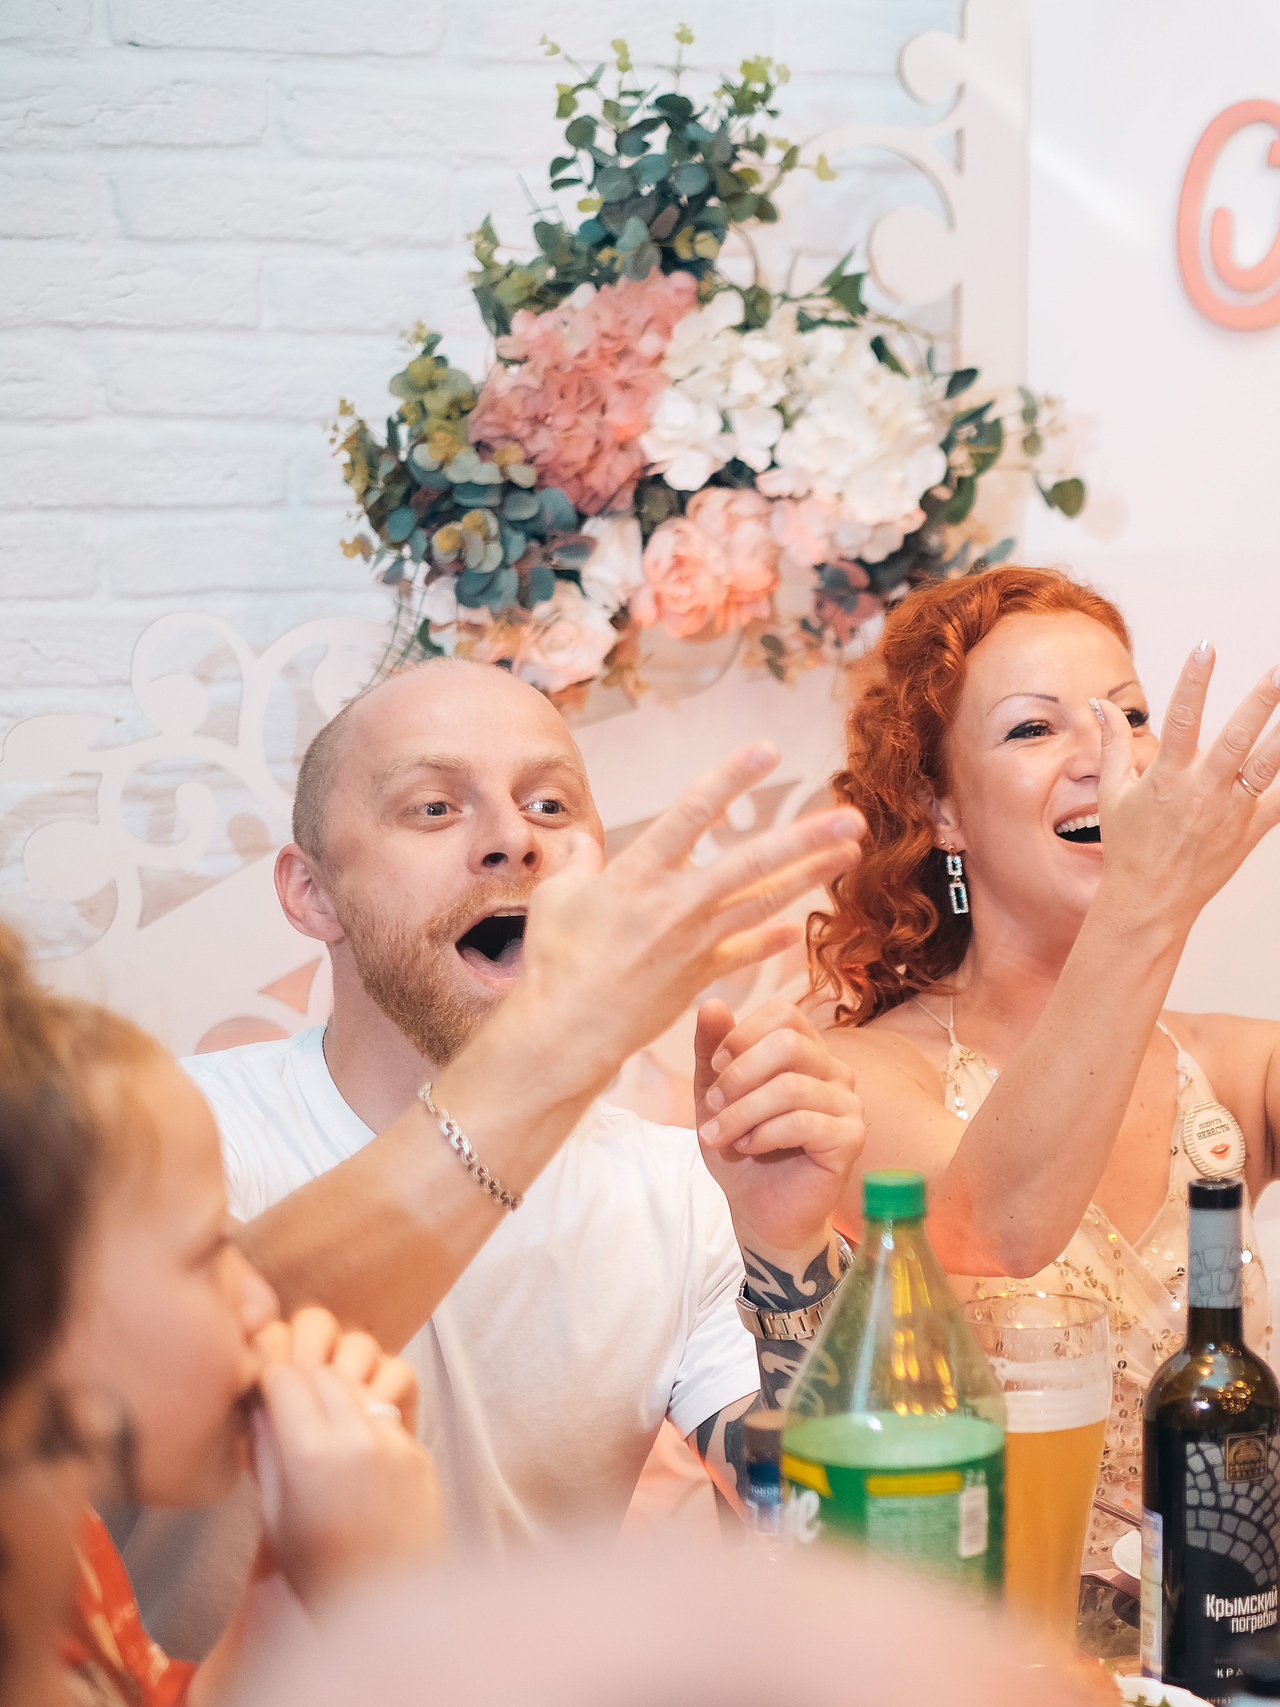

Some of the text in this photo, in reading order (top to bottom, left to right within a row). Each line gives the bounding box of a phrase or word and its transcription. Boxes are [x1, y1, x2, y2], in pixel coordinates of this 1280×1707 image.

[1196, 1124, 1230, 1140] НЕВЕСТЫ
[1205, 1584, 1279, 1623] Крымский
[1231, 1609, 1278, 1635] погребок
